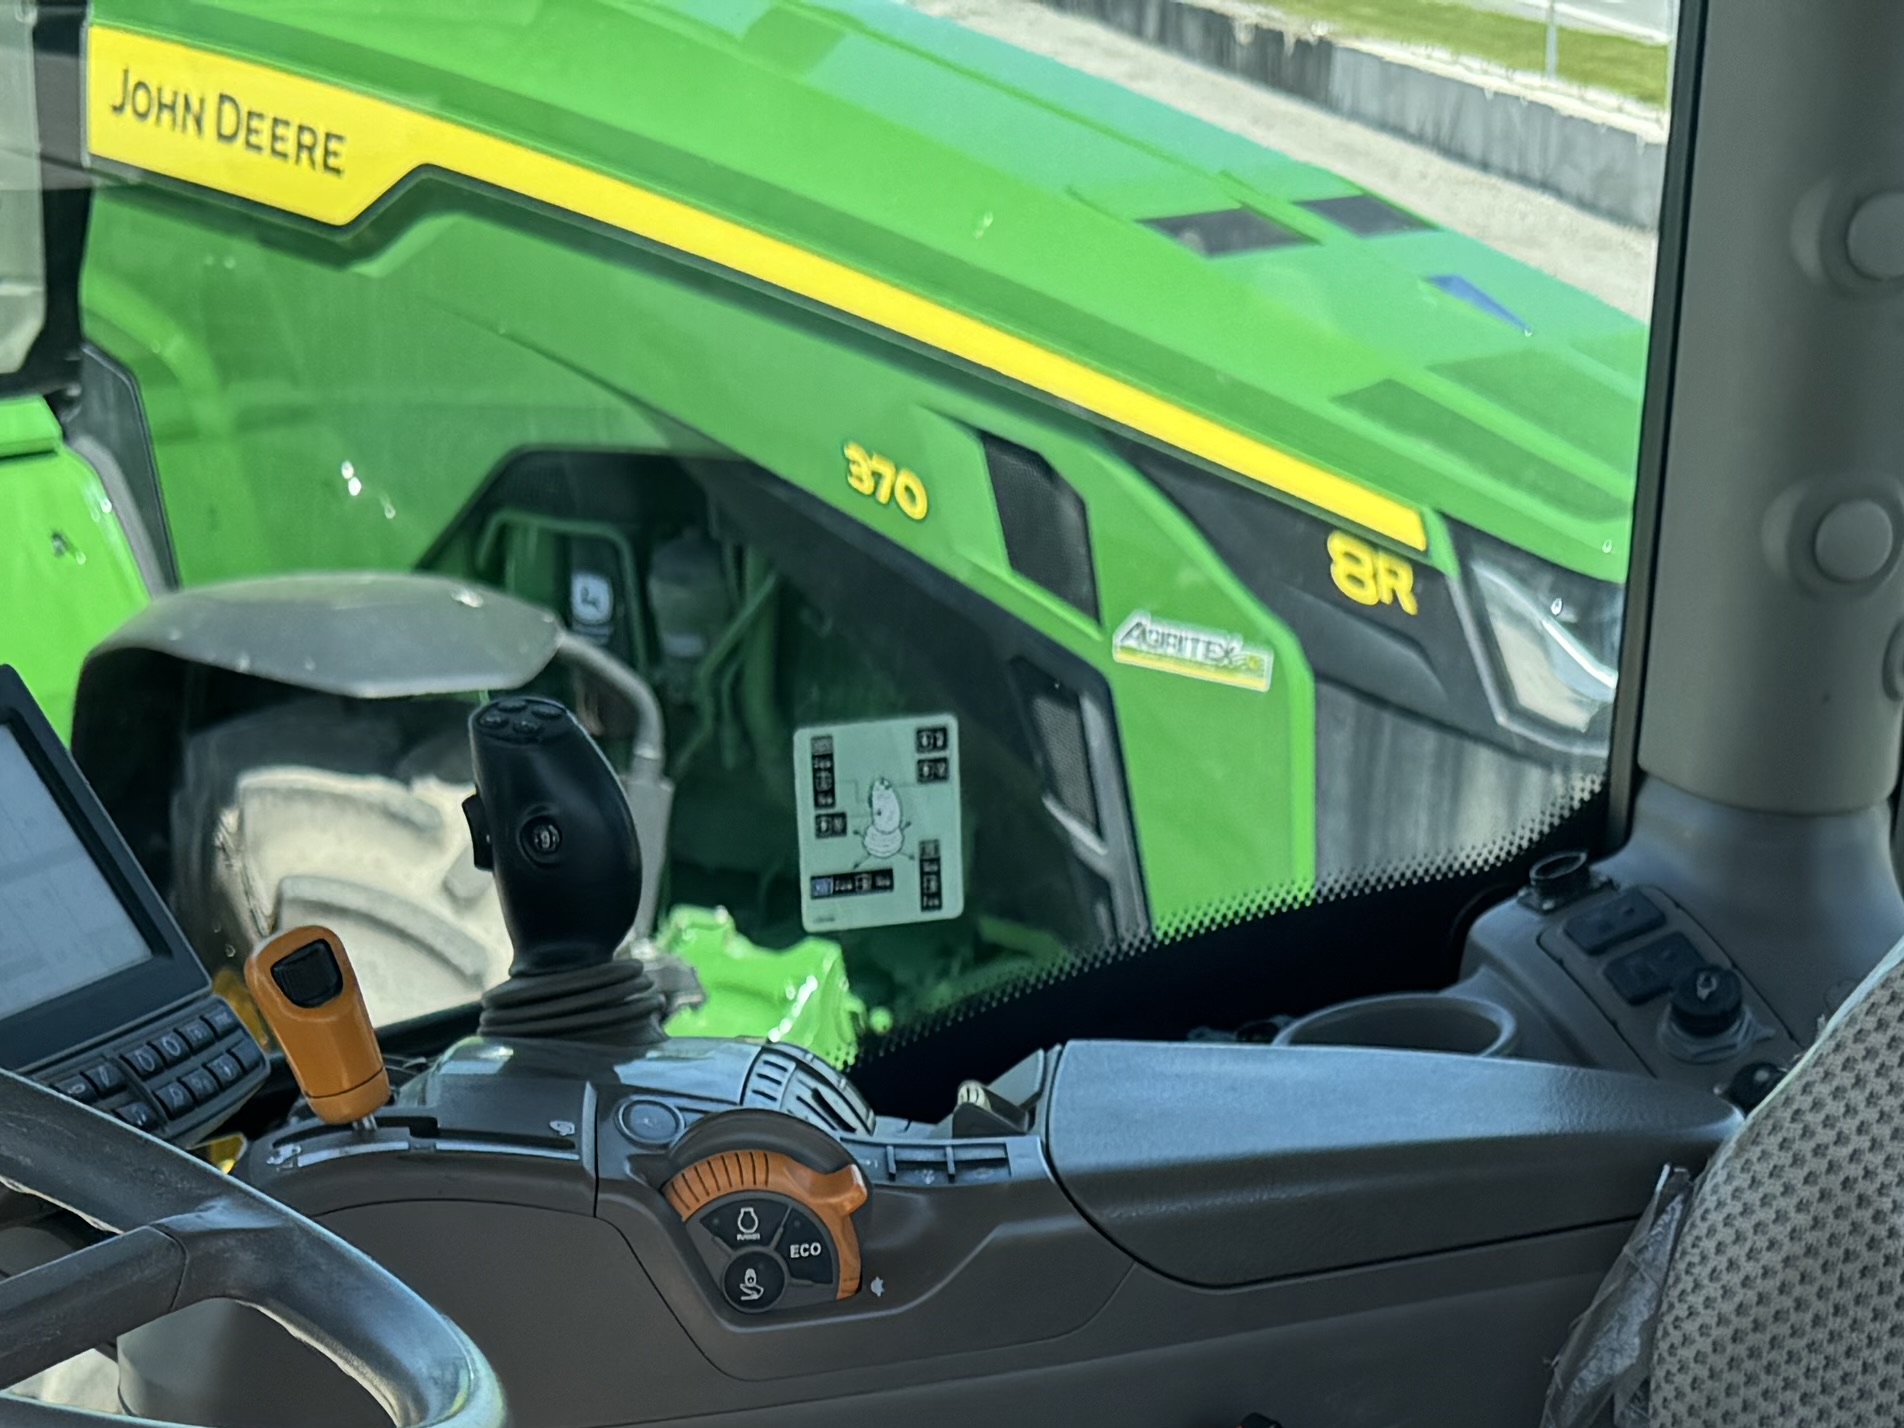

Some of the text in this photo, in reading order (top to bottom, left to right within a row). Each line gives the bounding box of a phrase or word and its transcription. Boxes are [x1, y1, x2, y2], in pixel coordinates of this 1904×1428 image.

[111, 67, 345, 177] JOHN DEERE
[843, 441, 928, 521] 370
[1326, 530, 1419, 616] 8R
[789, 1242, 822, 1259] ECO
